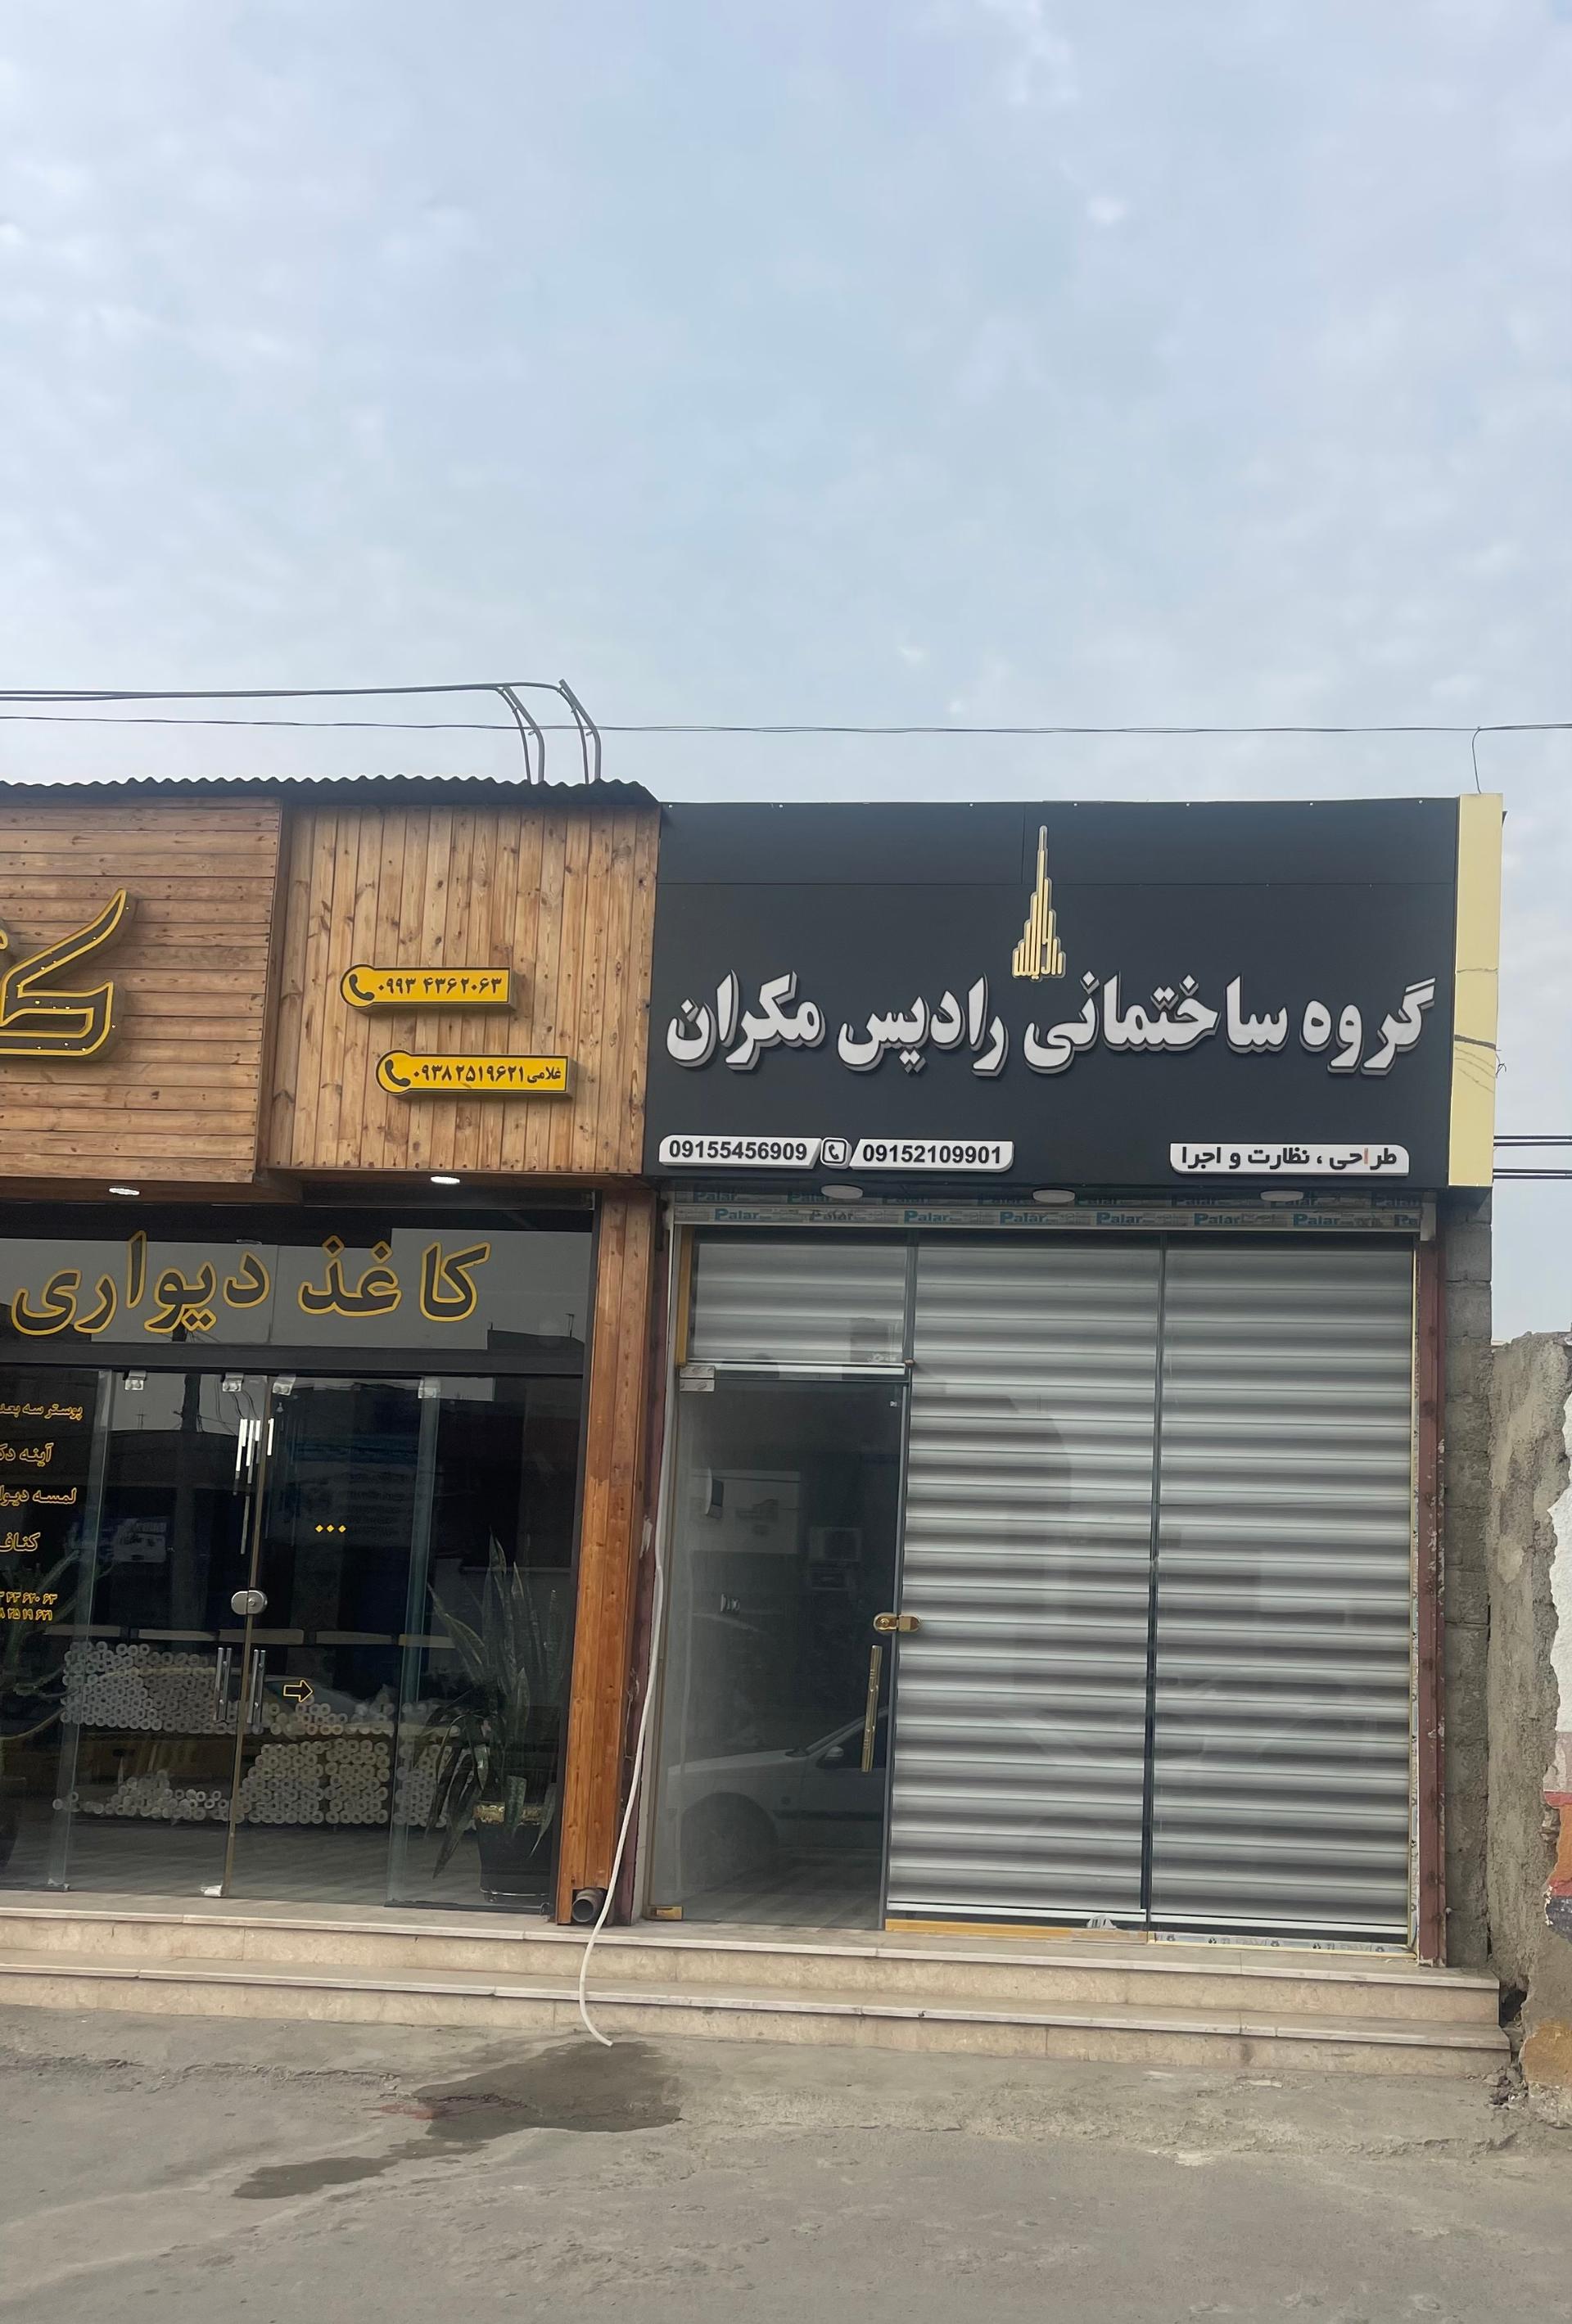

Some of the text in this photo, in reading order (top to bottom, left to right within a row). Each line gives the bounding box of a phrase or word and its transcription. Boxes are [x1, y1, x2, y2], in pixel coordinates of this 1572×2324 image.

[665, 969, 1437, 1076] گروه ساختمانی رادیس مکران
[526, 1067, 562, 1084] غلامی
[668, 1139, 808, 1162] 09155456909
[862, 1144, 1002, 1165] 09152109901
[1181, 1146, 1222, 1169] اجرا
[1228, 1151, 1241, 1170] و
[1247, 1146, 1311, 1170] نظارت
[1329, 1147, 1398, 1171] طراحی
[714, 1208, 760, 1221] Palar
[904, 1210, 950, 1224] Palar
[1000, 1211, 1047, 1225] Palar
[1096, 1212, 1143, 1225] Palar
[1194, 1212, 1240, 1226] Palar
[1294, 1213, 1340, 1226] Palar
[10, 1230, 272, 1336] دیواری
[22, 1403, 44, 1415] سه
[44, 1403, 83, 1420] پوستر
[19, 1442, 55, 1467] آینه
[32, 1487, 78, 1505] لمسه
